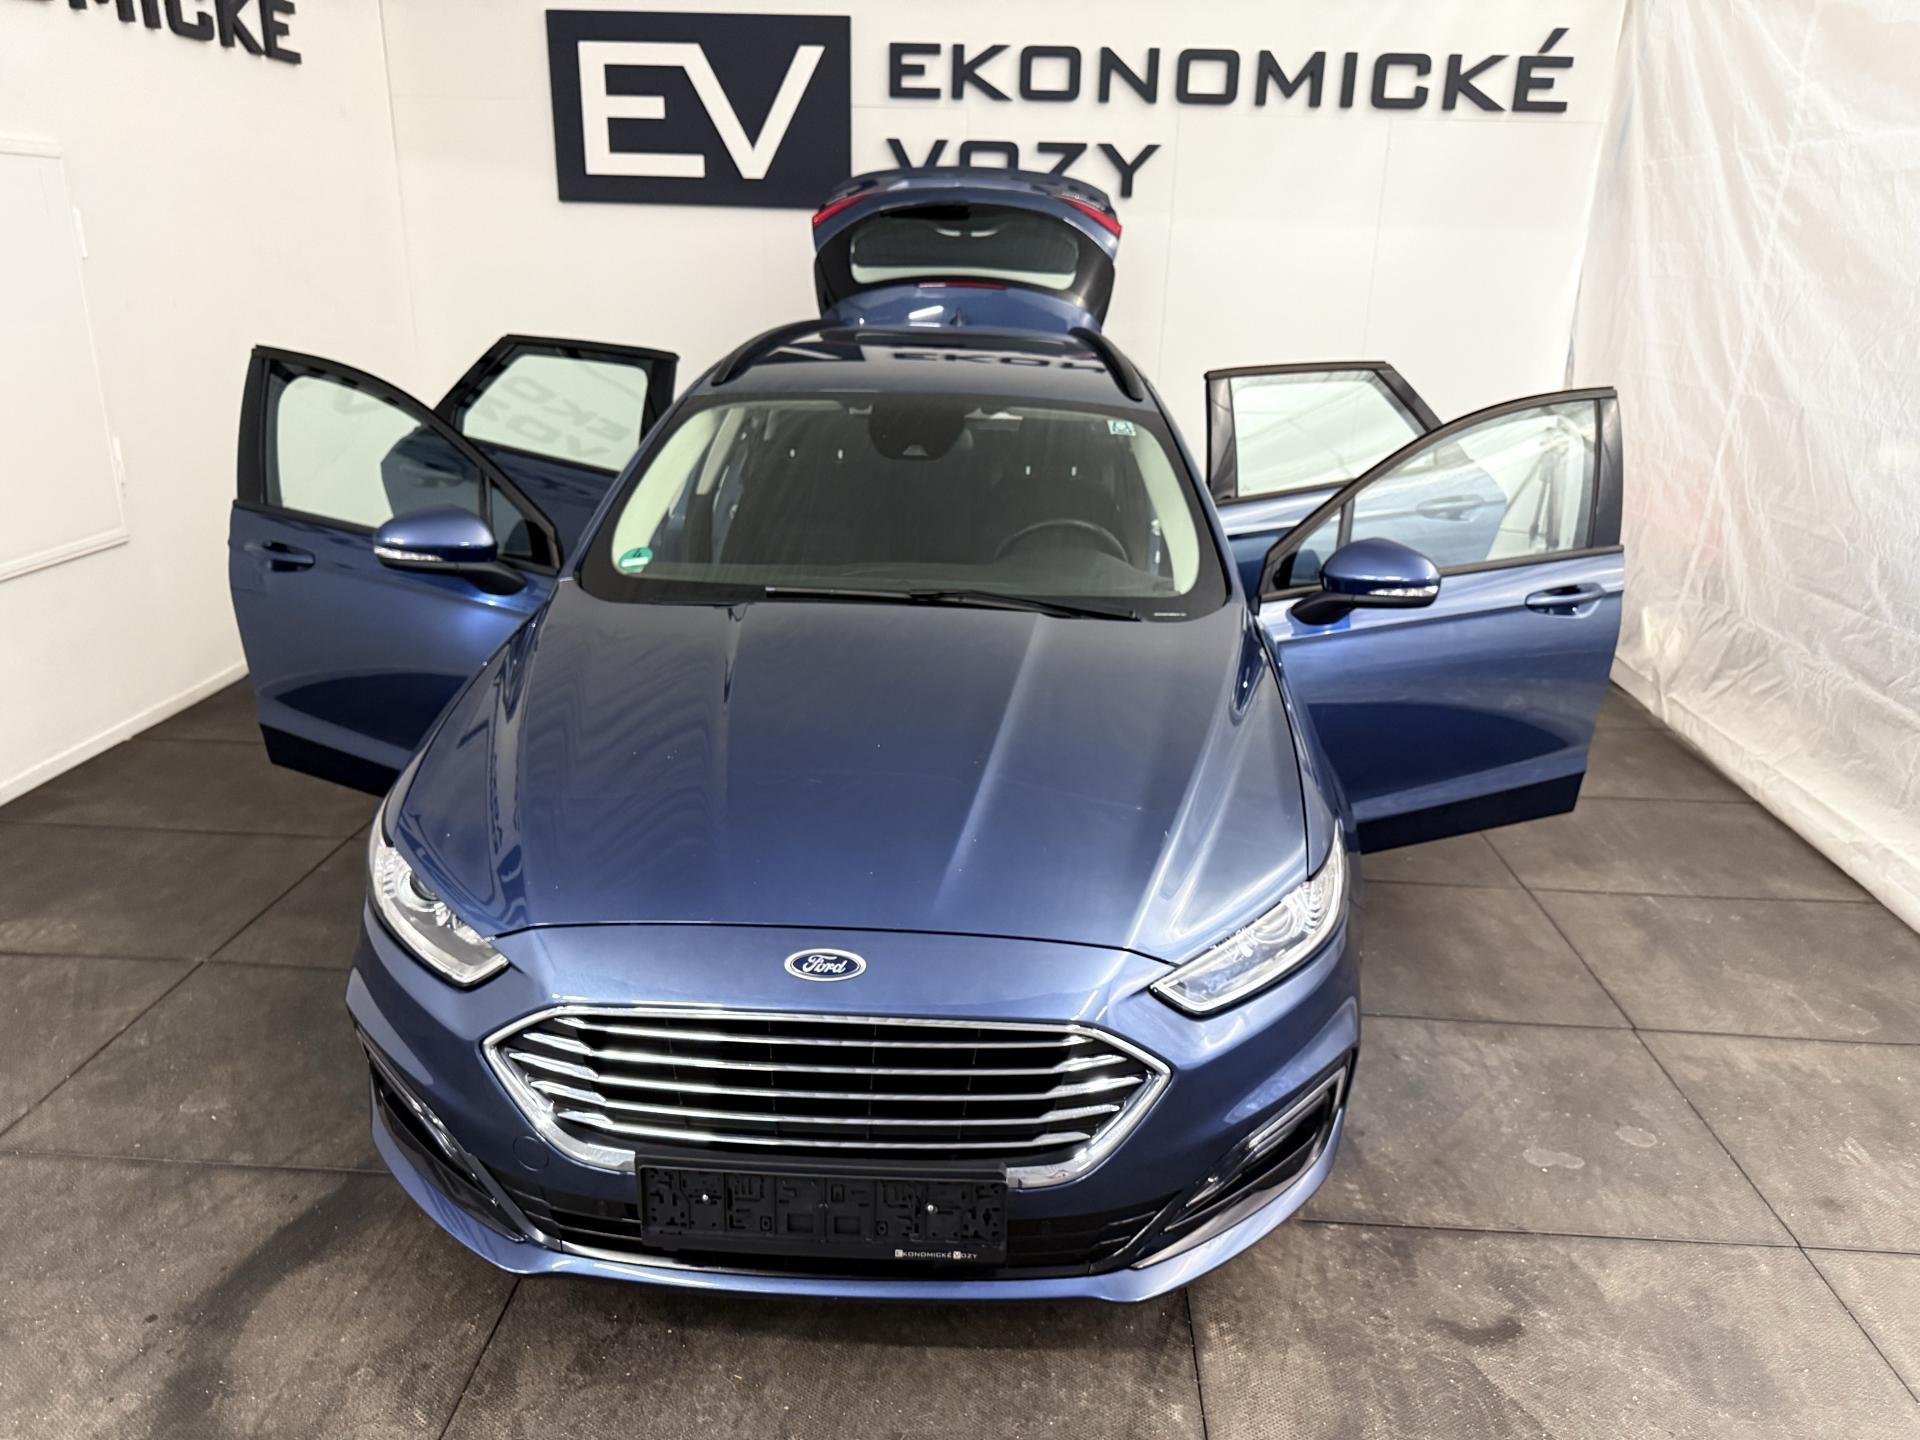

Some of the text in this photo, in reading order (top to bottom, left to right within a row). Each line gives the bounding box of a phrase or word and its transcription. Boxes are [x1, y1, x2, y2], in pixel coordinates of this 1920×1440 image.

[888, 27, 1574, 113] EKONOMICKÉ
[577, 40, 825, 181] EV
[886, 138, 1161, 198] VOZY
[802, 954, 848, 974] Ford
